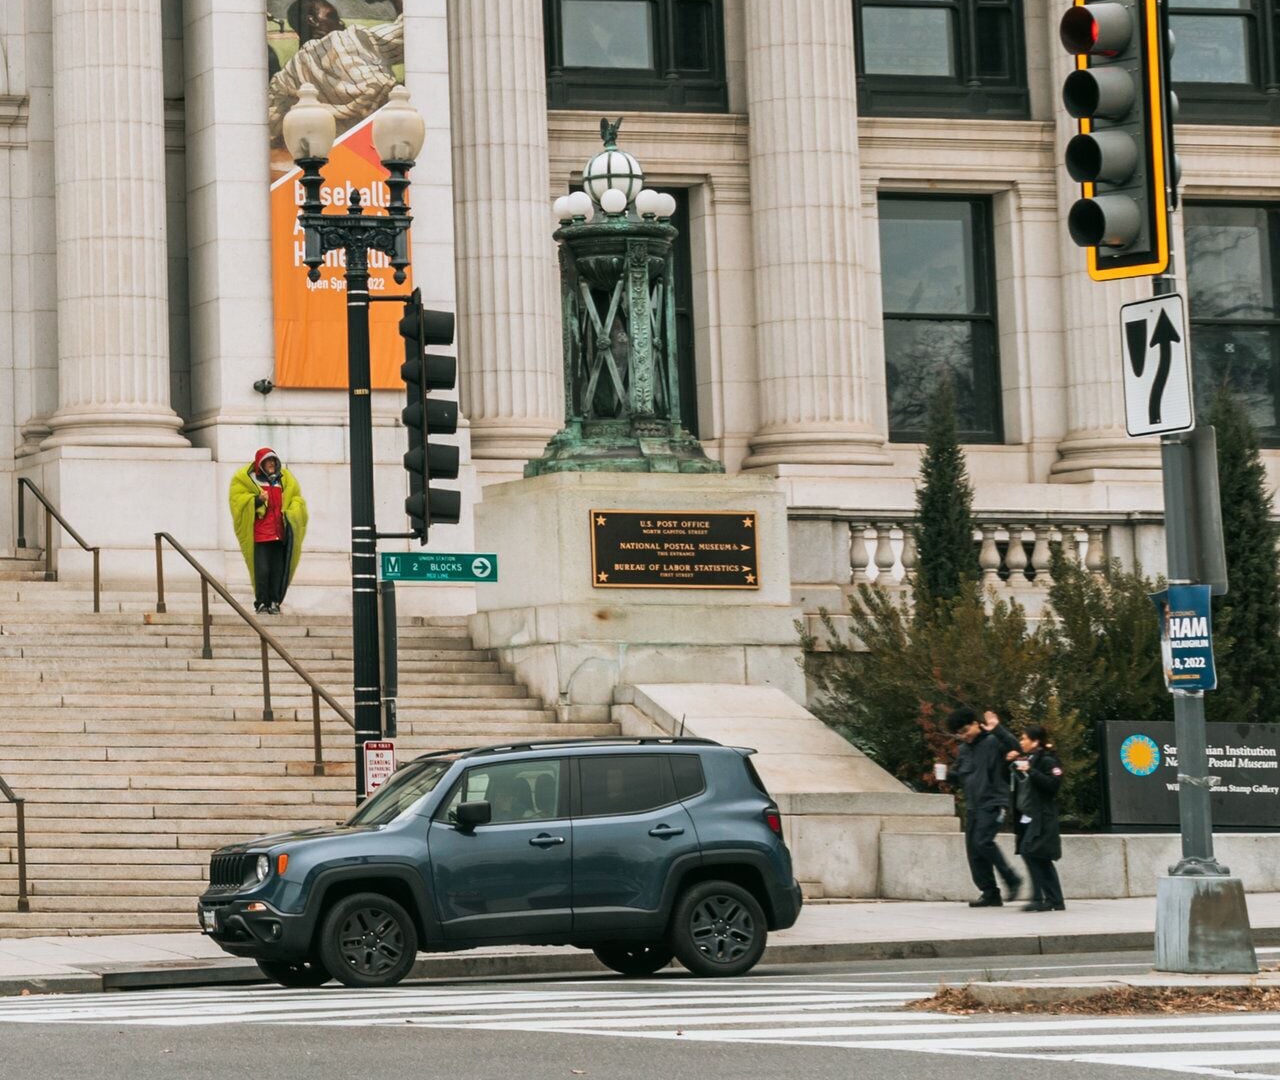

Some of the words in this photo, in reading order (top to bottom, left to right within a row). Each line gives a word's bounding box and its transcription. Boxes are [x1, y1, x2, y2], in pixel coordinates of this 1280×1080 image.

[640, 520, 654, 528] U.S.
[620, 542, 661, 550] NATIONAL
[699, 543, 732, 551] MUSEUM
[430, 563, 462, 572] BLOCKS
[614, 563, 645, 571] BUREAU
[694, 564, 740, 572] STATISTICS
[1183, 657, 1206, 669] 2022
[1225, 745, 1277, 756] Institution
[1208, 757, 1236, 768] Postal
[1237, 758, 1278, 768] Museum
[1229, 784, 1251, 794] Stamp
[1253, 784, 1279, 795] Gallery
